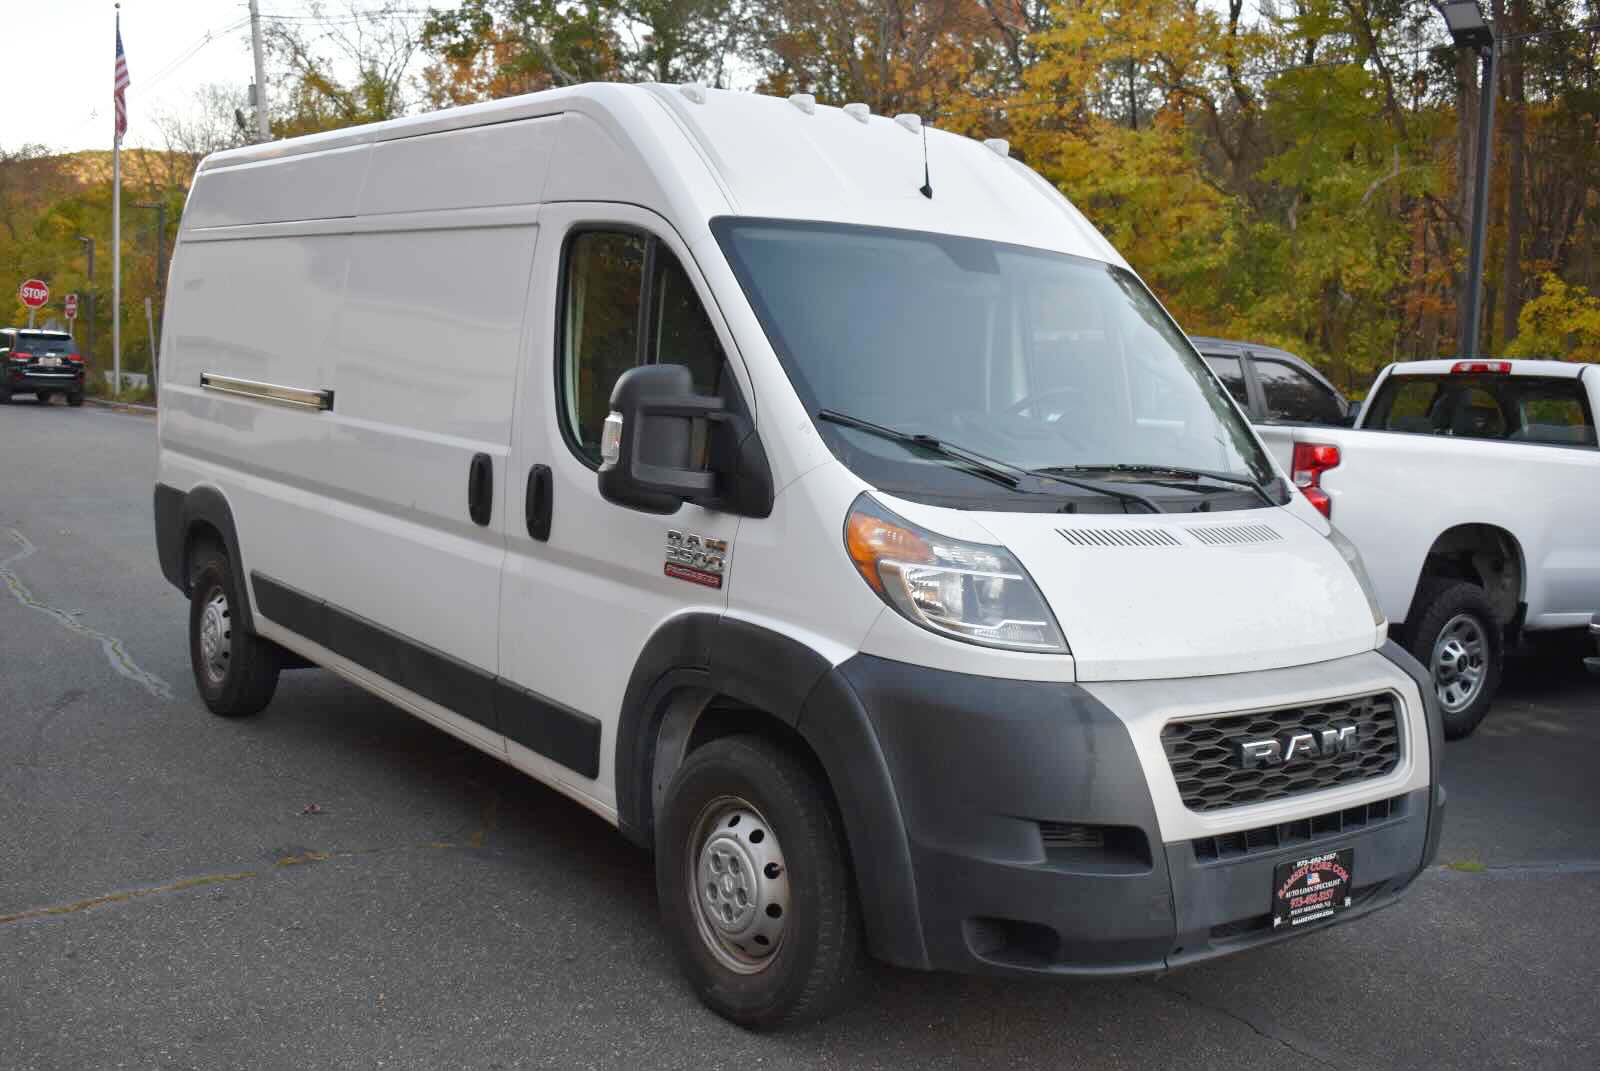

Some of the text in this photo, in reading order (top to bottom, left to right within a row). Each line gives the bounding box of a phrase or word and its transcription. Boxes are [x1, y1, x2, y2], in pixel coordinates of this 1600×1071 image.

[23, 287, 47, 300] STOP
[664, 529, 729, 555] RAM
[1242, 725, 1357, 768] RAM
[1285, 889, 1300, 899] AUTO
[1299, 886, 1314, 896] LOAN
